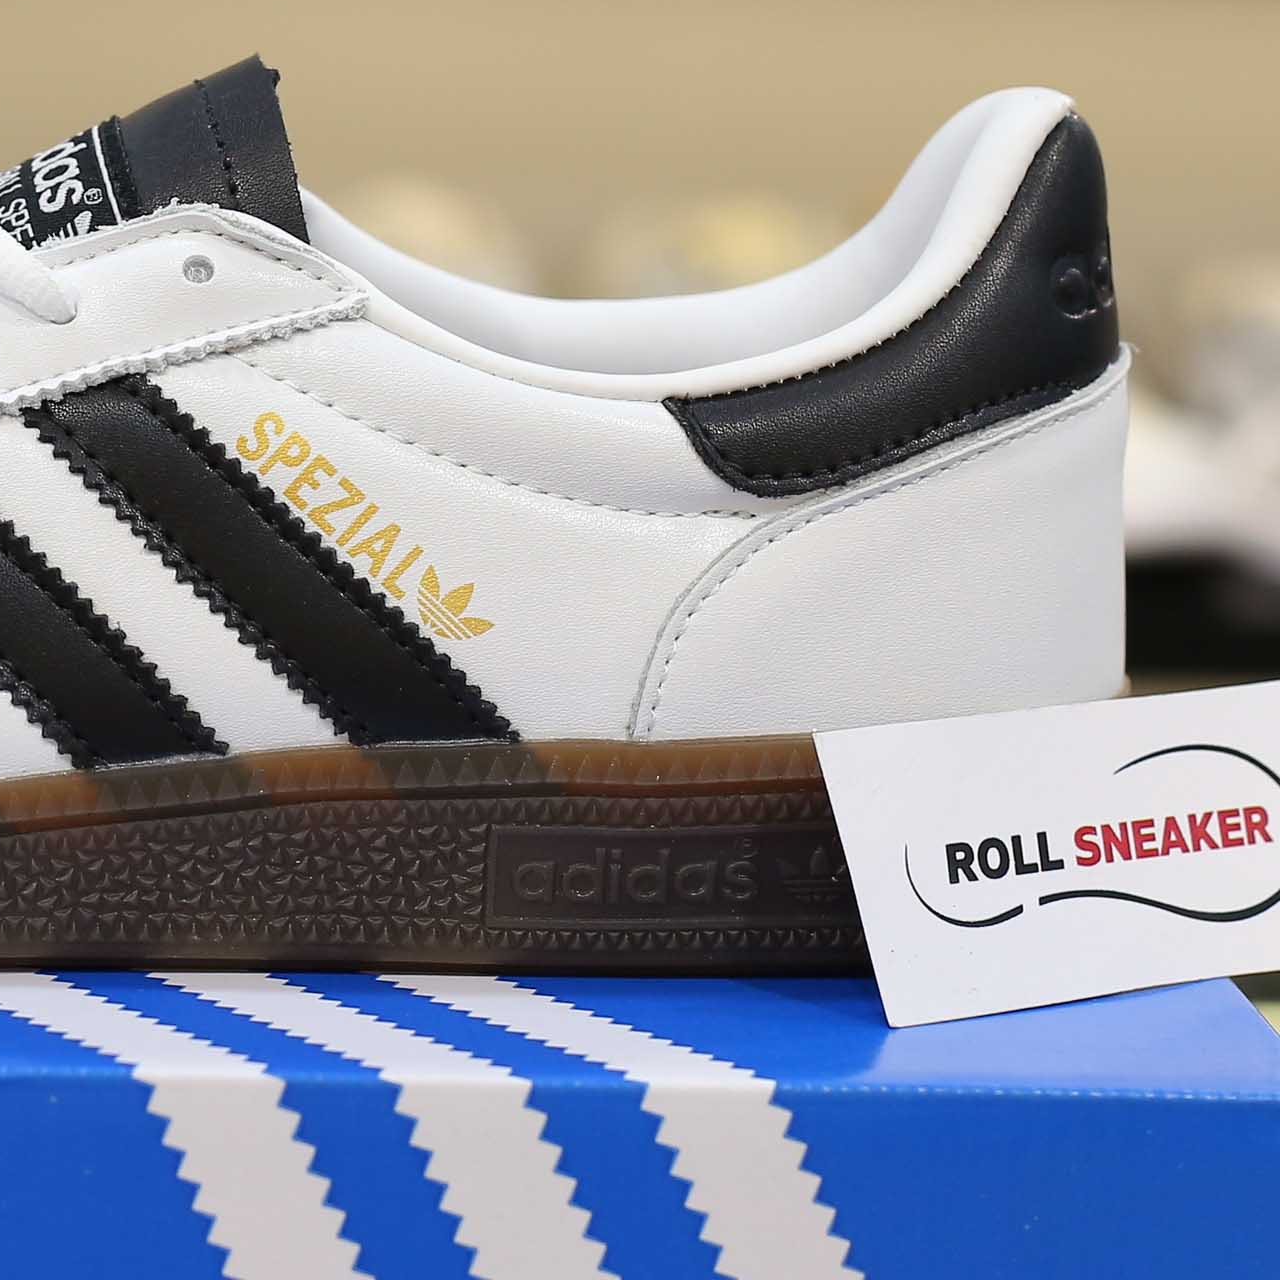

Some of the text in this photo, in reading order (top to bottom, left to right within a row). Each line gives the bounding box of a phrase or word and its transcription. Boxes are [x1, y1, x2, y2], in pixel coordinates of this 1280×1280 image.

[235, 410, 424, 601] SPEZIAL
[944, 804, 1274, 885] ROLL SNEAKER
